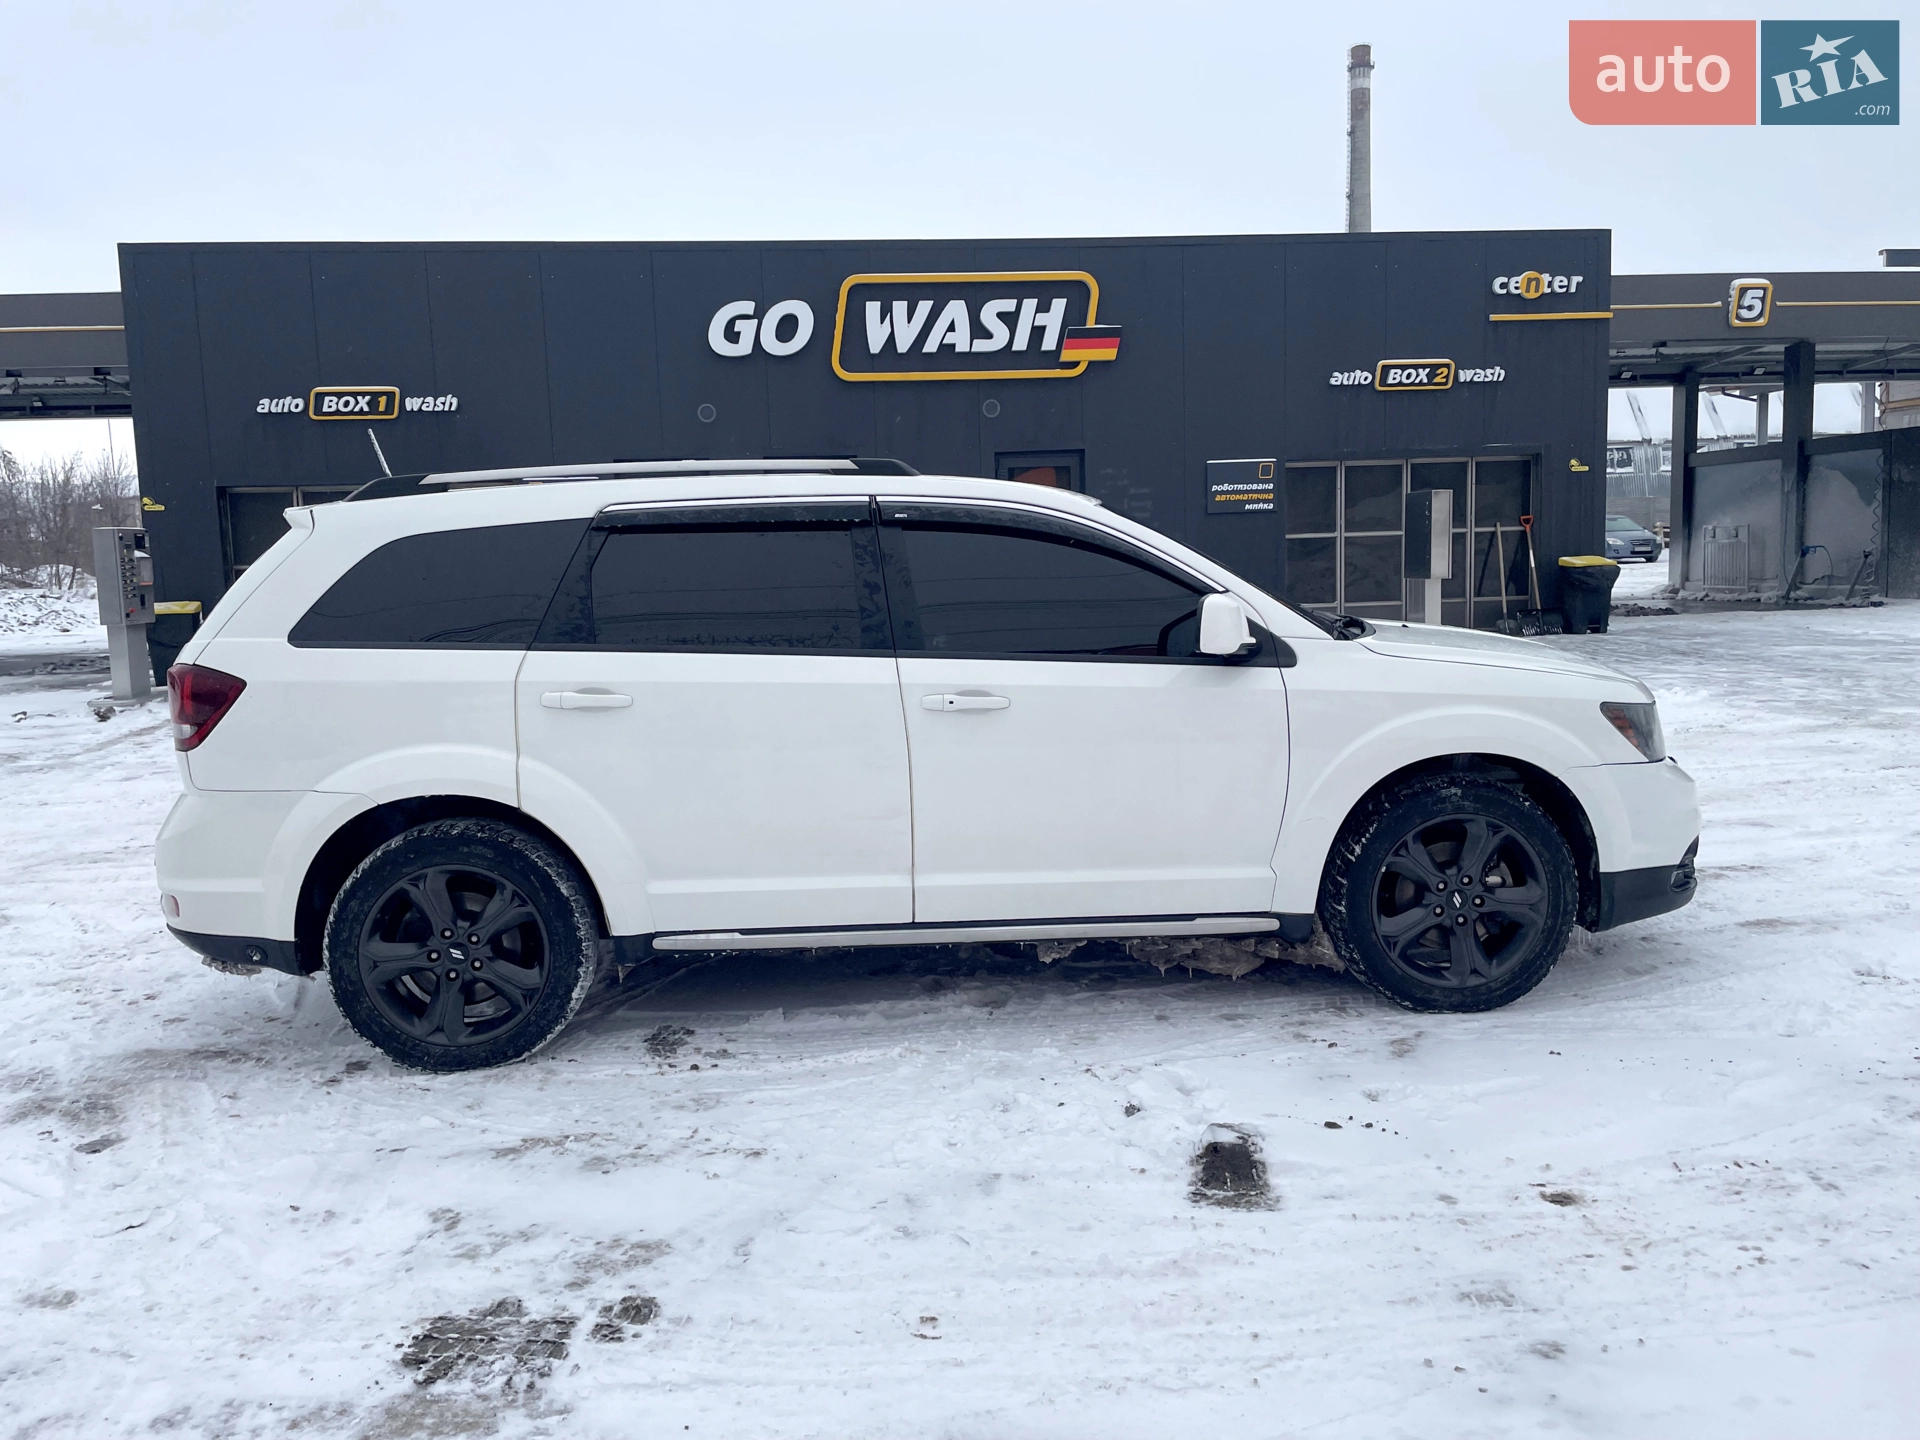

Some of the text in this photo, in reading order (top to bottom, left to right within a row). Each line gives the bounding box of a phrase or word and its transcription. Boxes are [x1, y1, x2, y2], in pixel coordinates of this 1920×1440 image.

[1492, 272, 1583, 298] center
[1737, 289, 1764, 319] 5
[707, 298, 1068, 357] GO WASH
[1329, 366, 1506, 386] auto BOX 2 wash
[256, 394, 459, 413] auto BOX 1 wash
[1211, 483, 1274, 492] роботизована
[1215, 493, 1274, 501] автоматична
[1244, 502, 1274, 511] мийка
